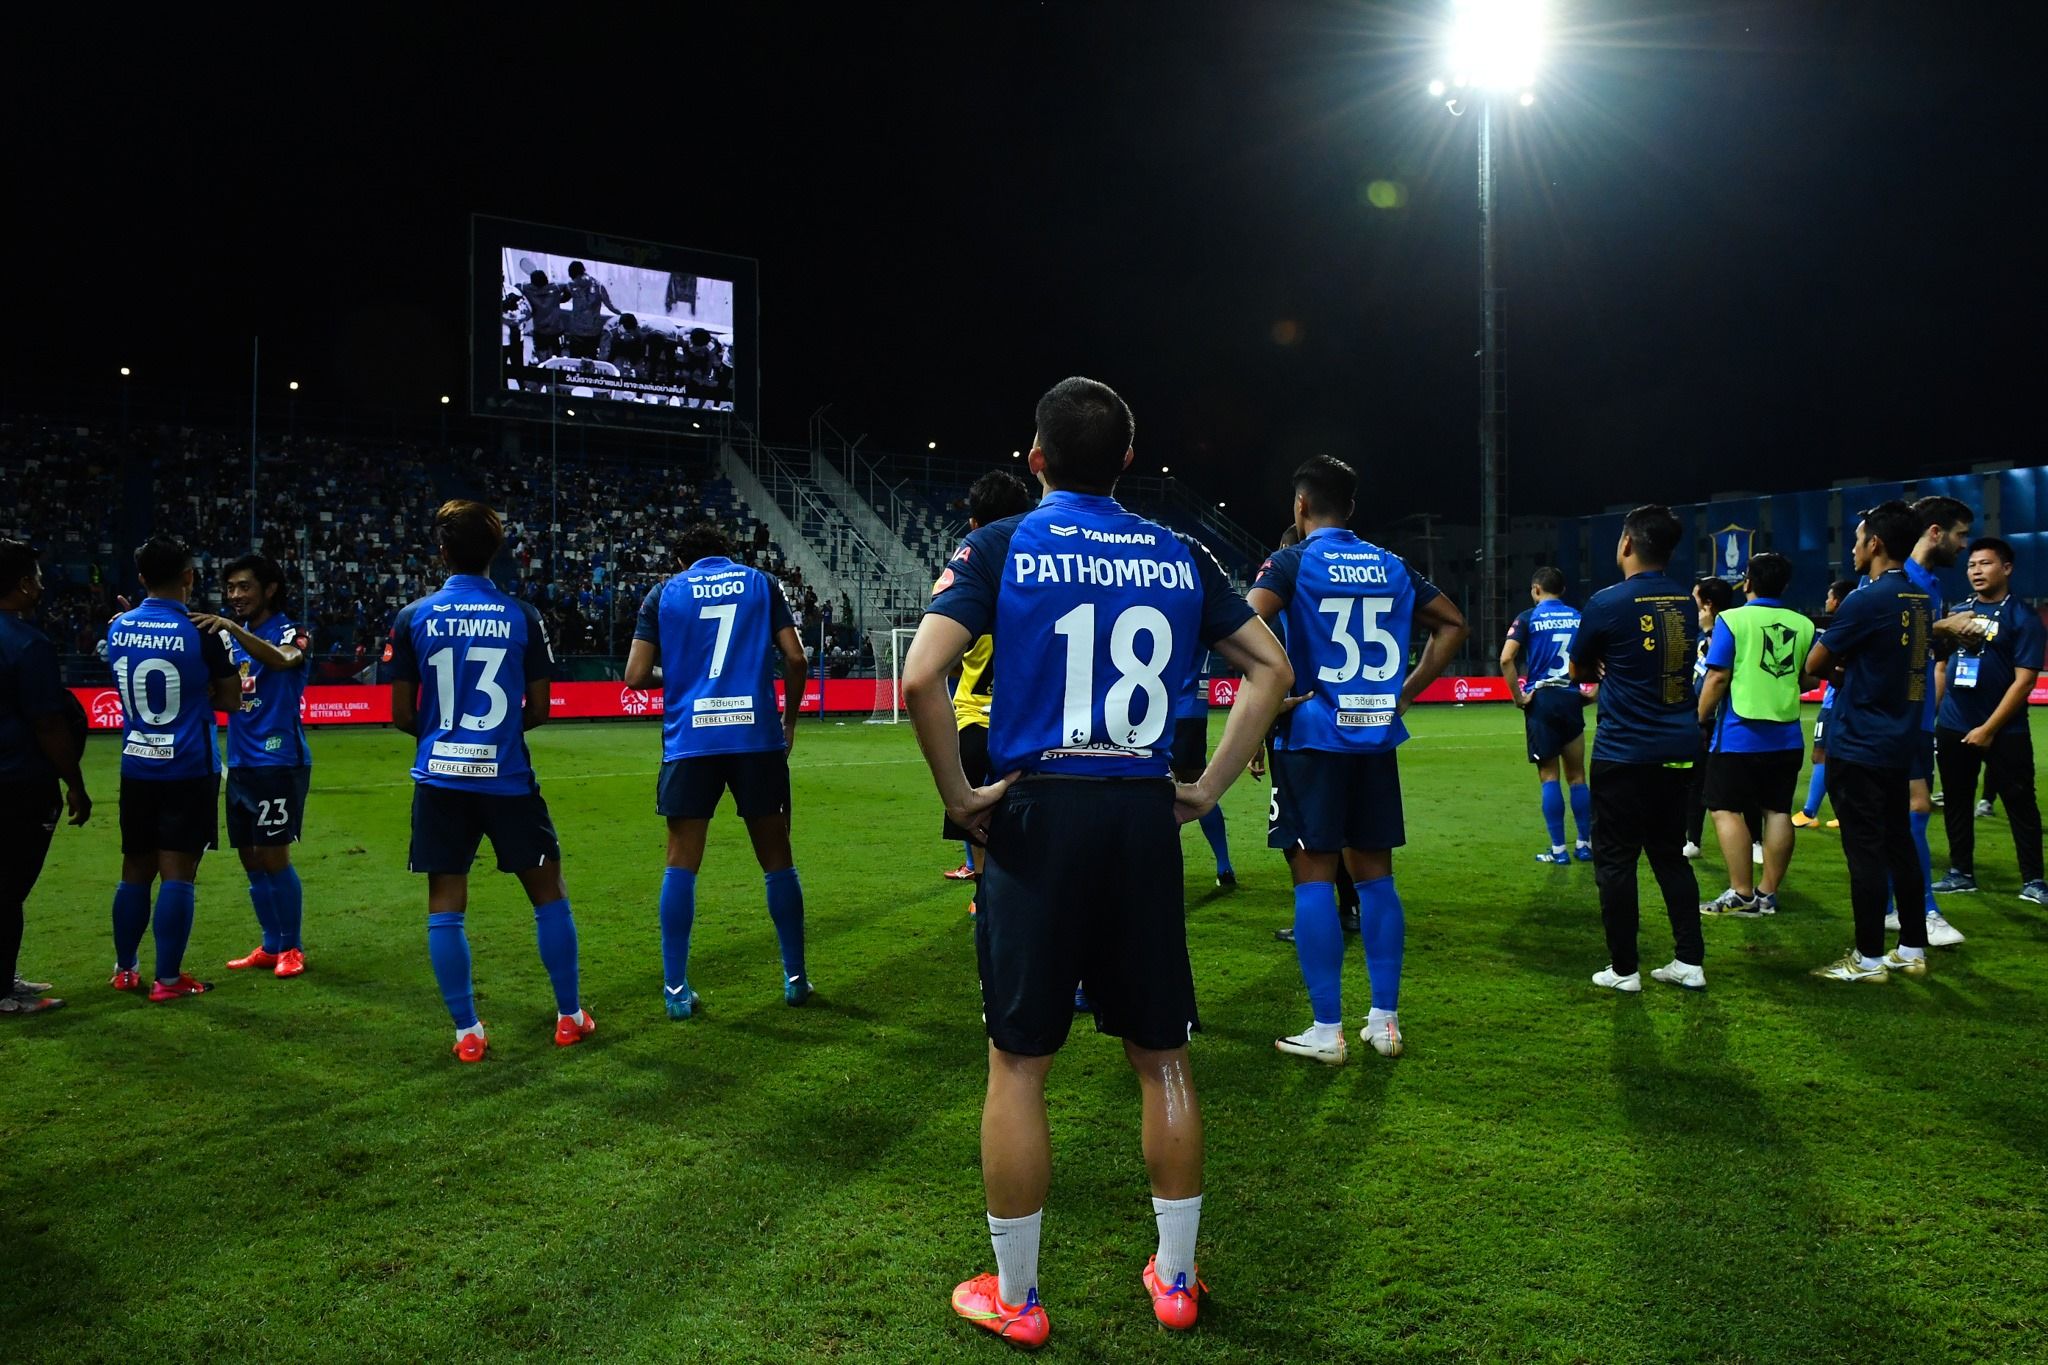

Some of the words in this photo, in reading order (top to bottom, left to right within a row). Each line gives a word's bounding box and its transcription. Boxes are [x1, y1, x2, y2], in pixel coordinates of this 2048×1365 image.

[1081, 528, 1156, 546] YANMAR
[1340, 553, 1380, 561] YANMAR
[704, 571, 746, 582] YANMAR
[1014, 553, 1194, 590] PATHOMPON
[1328, 564, 1388, 583] SIROCH
[692, 580, 745, 599] DIOGO
[453, 603, 505, 613] YANMAR
[136, 621, 179, 629] YANMAR
[426, 618, 511, 639] K.TAWAN
[1533, 618, 1582, 632] THOSSAPO
[111, 631, 185, 652] SUMANYA
[699, 603, 738, 680] 7
[1317, 597, 1401, 683] 35
[1547, 633, 1573, 677] 3
[1054, 603, 1173, 749] 18
[113, 655, 181, 726] 10
[428, 647, 508, 732] 13
[310, 710, 333, 718] BETTER
[695, 716, 722, 725] STIEBEL
[1340, 715, 1365, 723] STIEBEL
[430, 762, 460, 772] STIEBEL
[462, 764, 496, 774] ELTRON
[257, 798, 288, 827] 23
